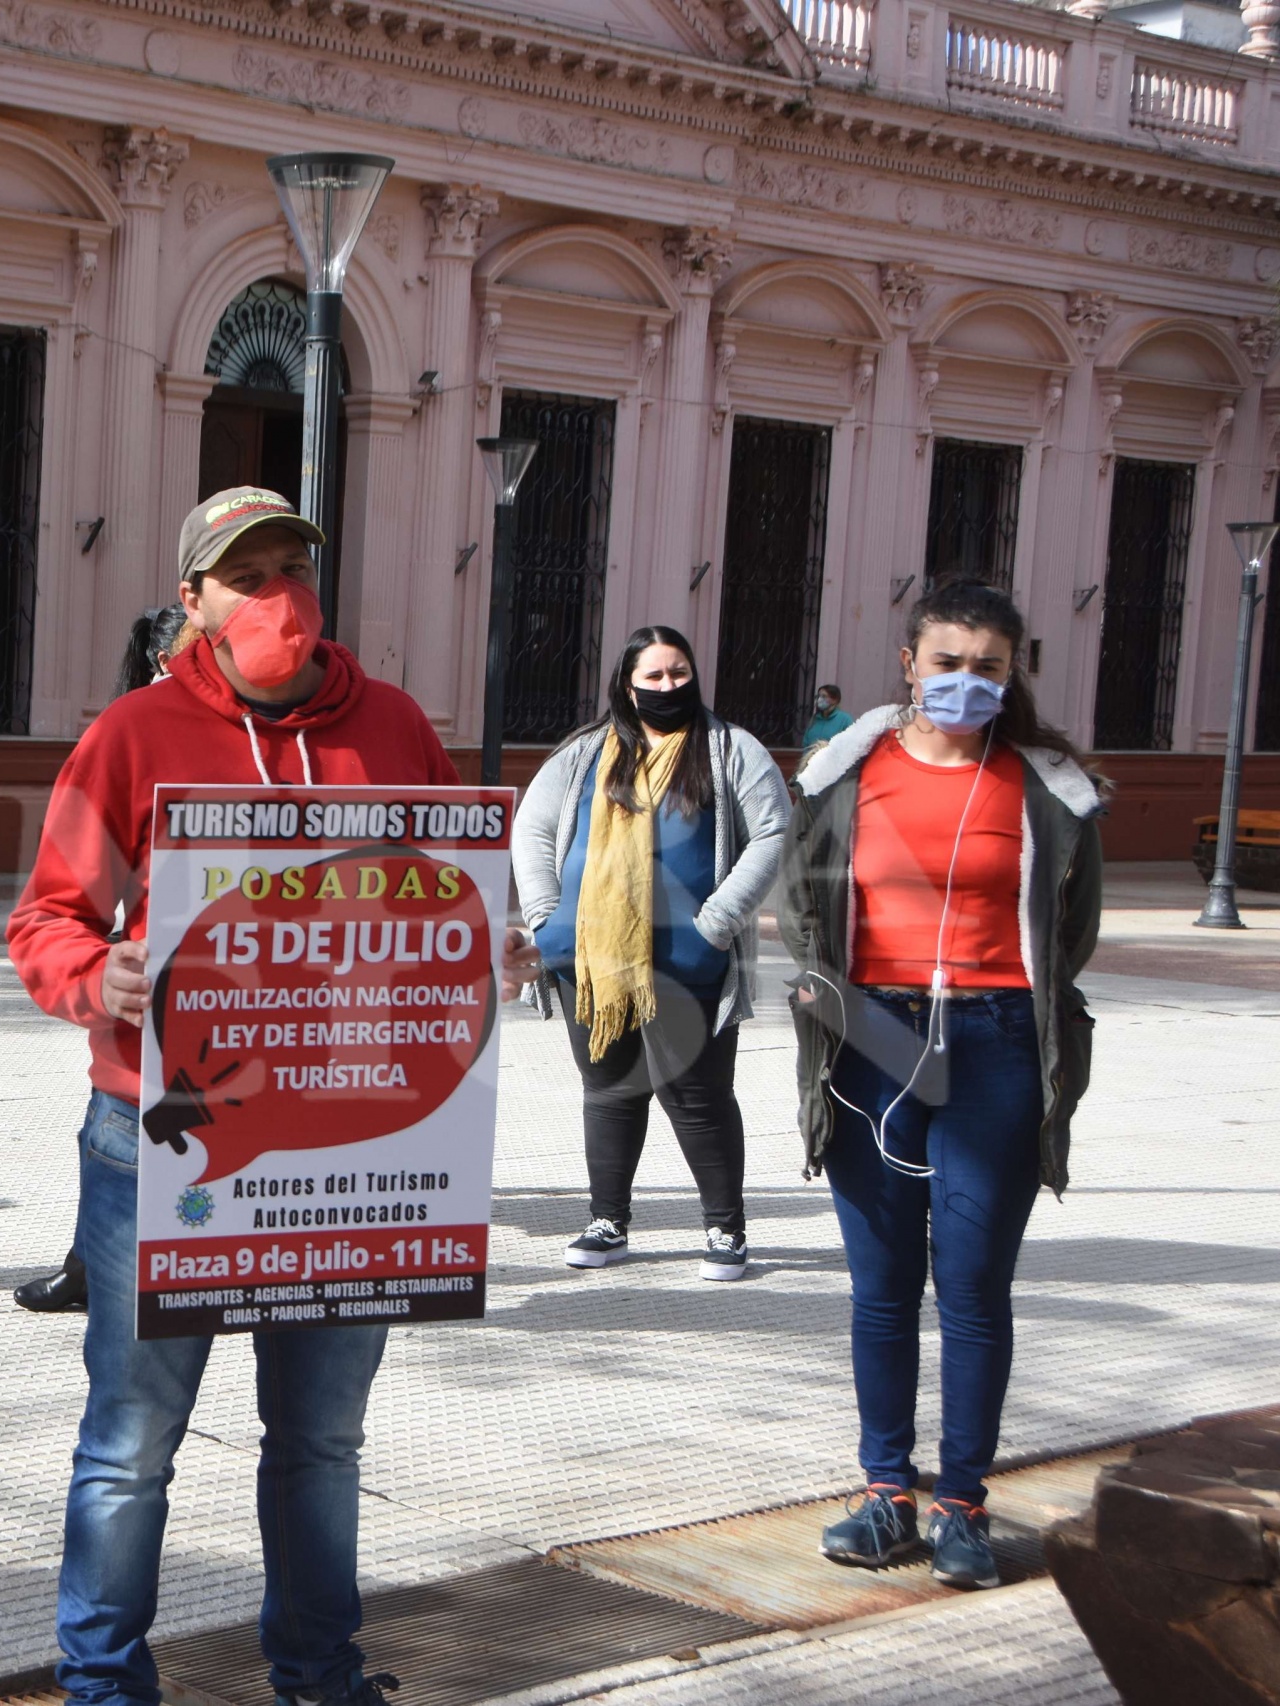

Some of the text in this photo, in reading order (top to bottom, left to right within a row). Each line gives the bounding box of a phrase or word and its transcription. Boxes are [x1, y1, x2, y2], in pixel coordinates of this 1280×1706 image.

[167, 802, 503, 839] TURISMO SOMOS TODOS
[201, 865, 461, 900] POSADAS
[205, 920, 473, 975] 15 DE JULIO
[176, 981, 478, 1012] MOVILIZACIÓN NACIONAL
[212, 1020, 471, 1049] LEY DE EMERGENCIA
[273, 1058, 407, 1090] TURÍSTICA
[233, 1169, 450, 1199] Actores del Turismo
[253, 1202, 428, 1229] Autoconvocados
[150, 1251, 230, 1282] Plaza
[236, 1247, 256, 1277] 9
[260, 1245, 297, 1275] de
[301, 1240, 369, 1280] julio
[390, 1239, 422, 1267] 11
[431, 1237, 477, 1266] Hs.
[158, 1276, 474, 1309] TRANSPORTES AGENCIAS HOTELES RESTAURANTES
[223, 1300, 410, 1325] GUIAS PARQUES REGIONALES
